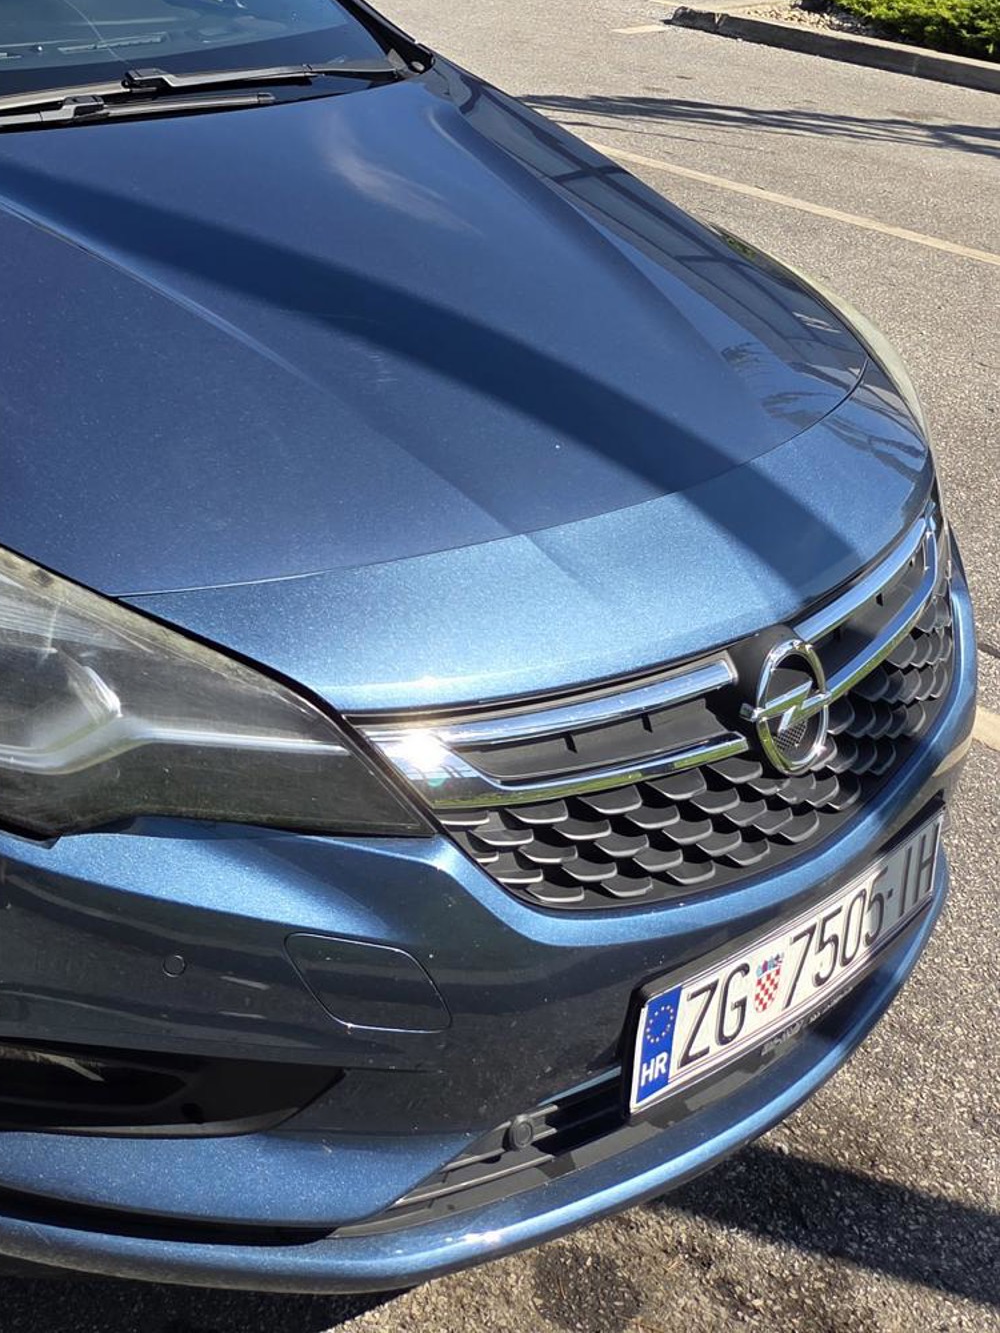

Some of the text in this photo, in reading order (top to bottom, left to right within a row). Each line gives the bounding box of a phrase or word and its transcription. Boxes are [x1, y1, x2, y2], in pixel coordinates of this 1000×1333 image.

[679, 963, 750, 1068] ZG
[784, 822, 940, 1010] 7505-IH
[640, 1052, 668, 1086] HR
